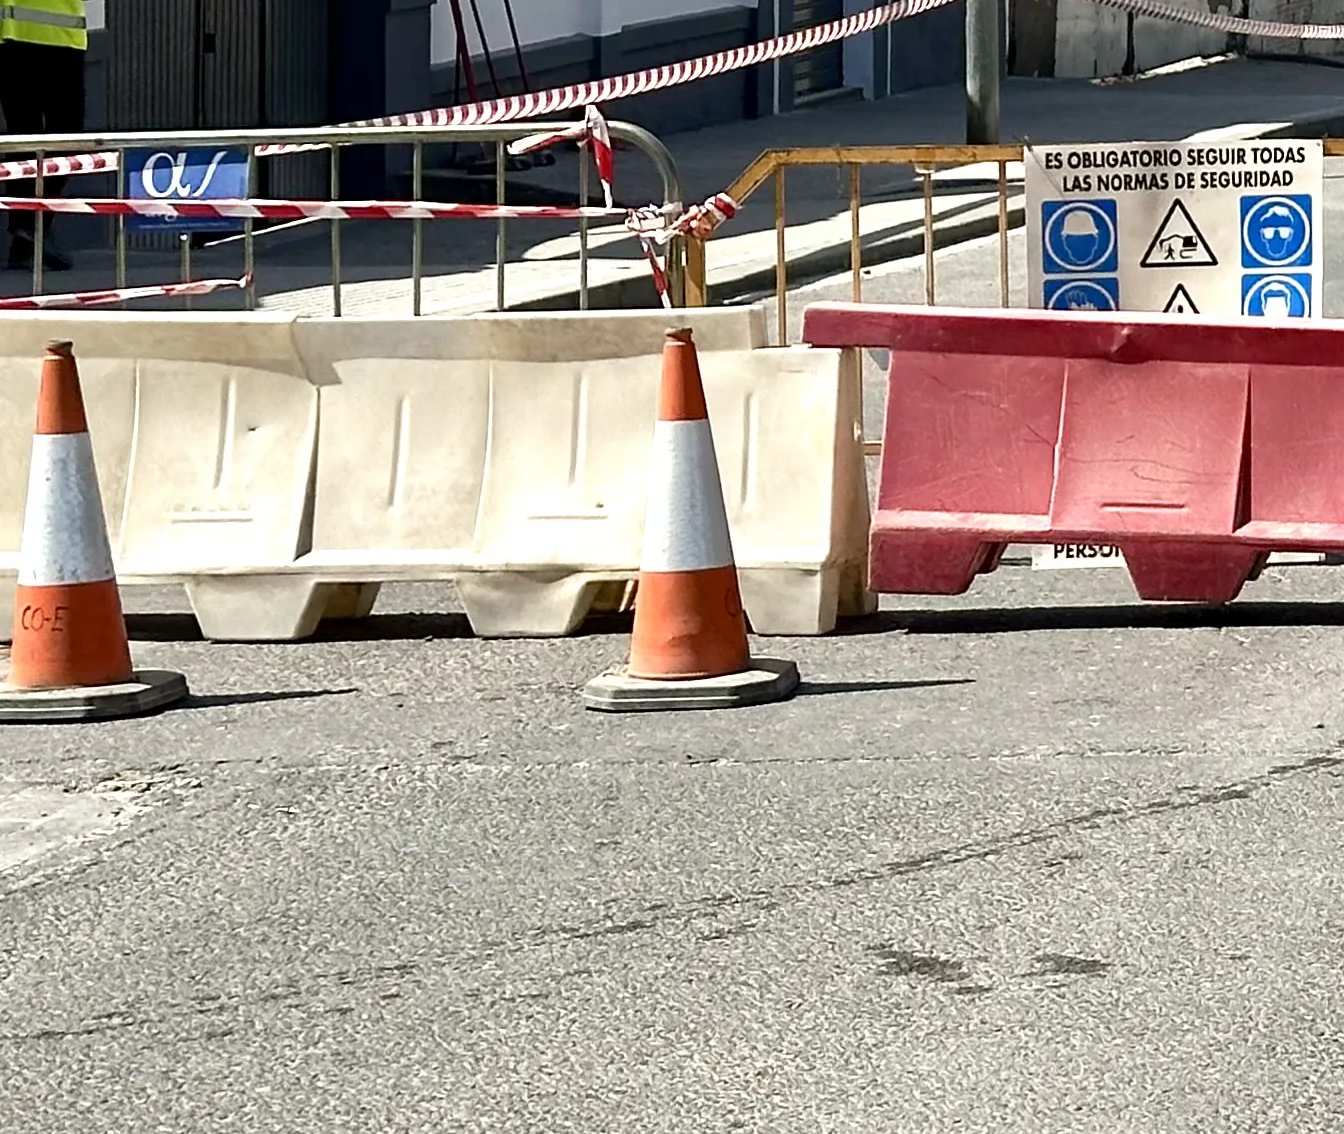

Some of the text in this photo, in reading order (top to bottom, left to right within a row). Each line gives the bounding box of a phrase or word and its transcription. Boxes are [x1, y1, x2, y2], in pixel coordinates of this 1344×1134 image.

[1045, 147, 1305, 170] ES OBLIGATORIO SEGUIR TODAS
[1063, 170, 1294, 192] LAS NORMAS DE SEGURIDAD
